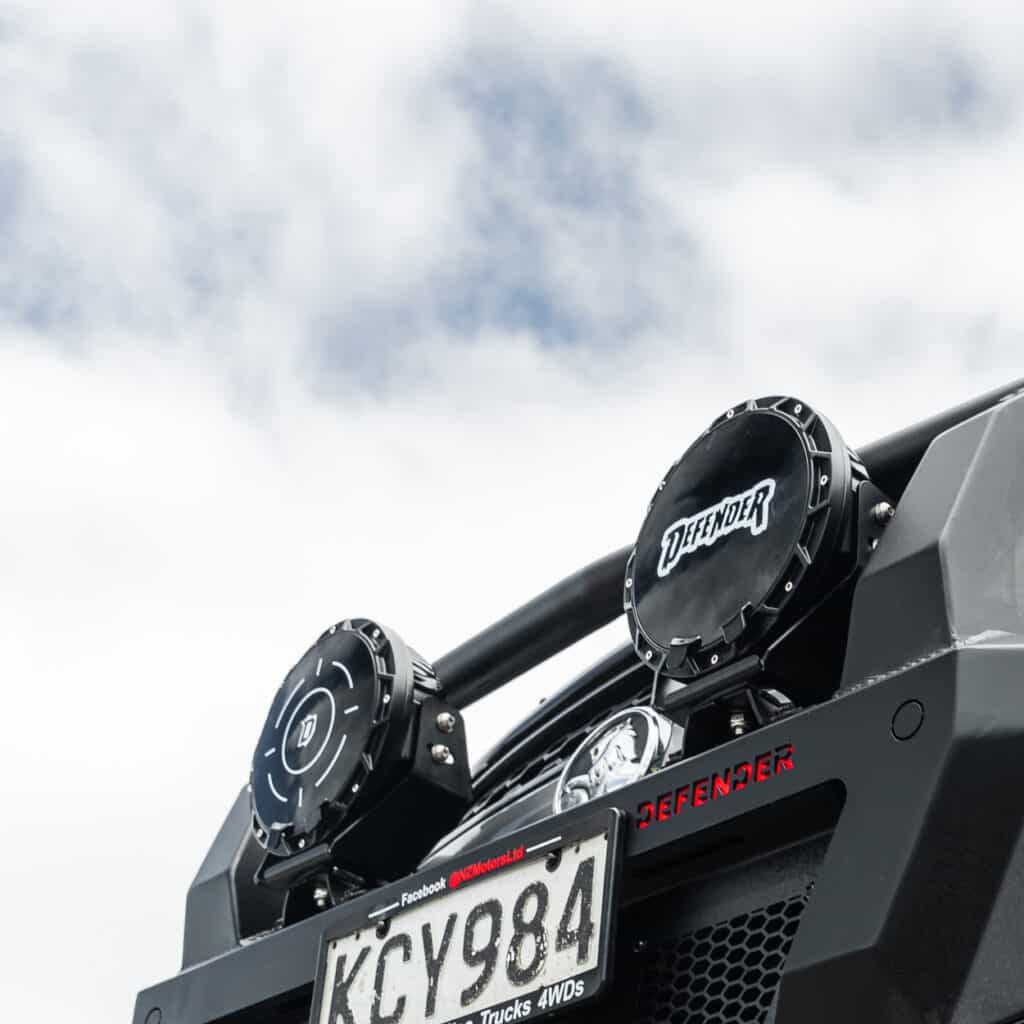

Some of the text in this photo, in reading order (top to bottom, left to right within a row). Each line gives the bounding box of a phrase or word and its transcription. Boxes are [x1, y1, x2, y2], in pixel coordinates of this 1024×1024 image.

[657, 478, 776, 578] DEFENDER
[636, 743, 795, 829] DEFENDER
[401, 878, 447, 907] Facebook
[538, 979, 585, 1010] 4WDs
